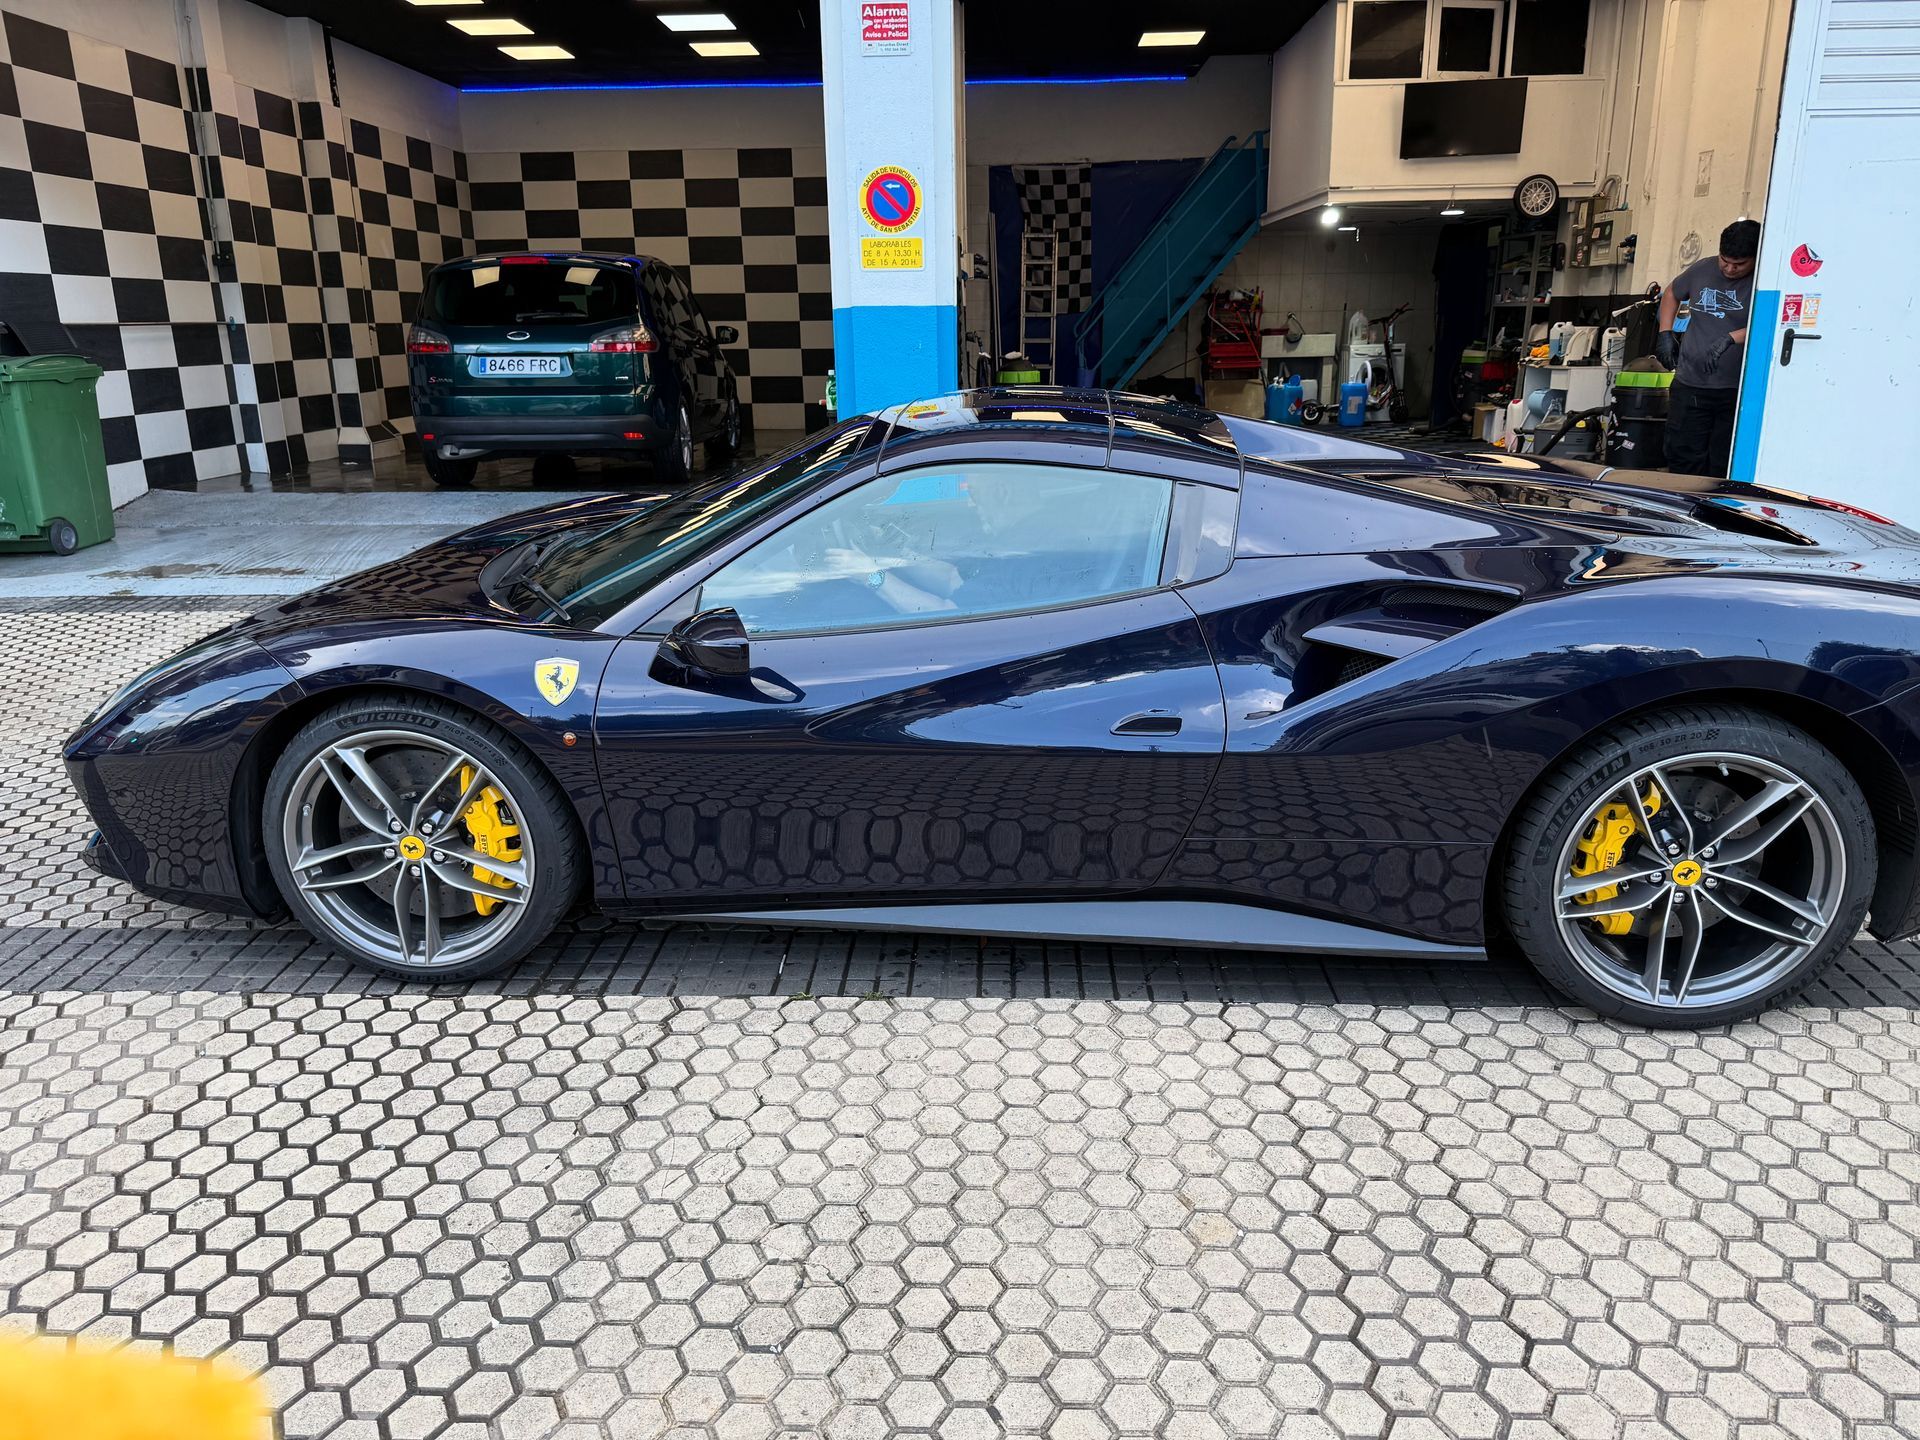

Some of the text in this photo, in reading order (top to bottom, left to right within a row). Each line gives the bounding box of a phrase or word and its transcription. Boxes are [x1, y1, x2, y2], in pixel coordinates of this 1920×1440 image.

[863, 5, 907, 17] Alarma
[863, 170, 881, 188] SALIDA
[889, 166, 918, 188] VEHICULOS
[870, 220, 879, 229] DE
[879, 225, 893, 233] SAN
[893, 206, 921, 233] SEBASTIAN
[489, 359, 557, 372] 8466 FRC
[356, 712, 436, 727] MICHELIN
[444, 725, 488, 751] PILOT SPORT
[1674, 733, 1688, 743] ZR
[1689, 732, 1703, 740] 20
[1545, 755, 1626, 840] MICHELIN
